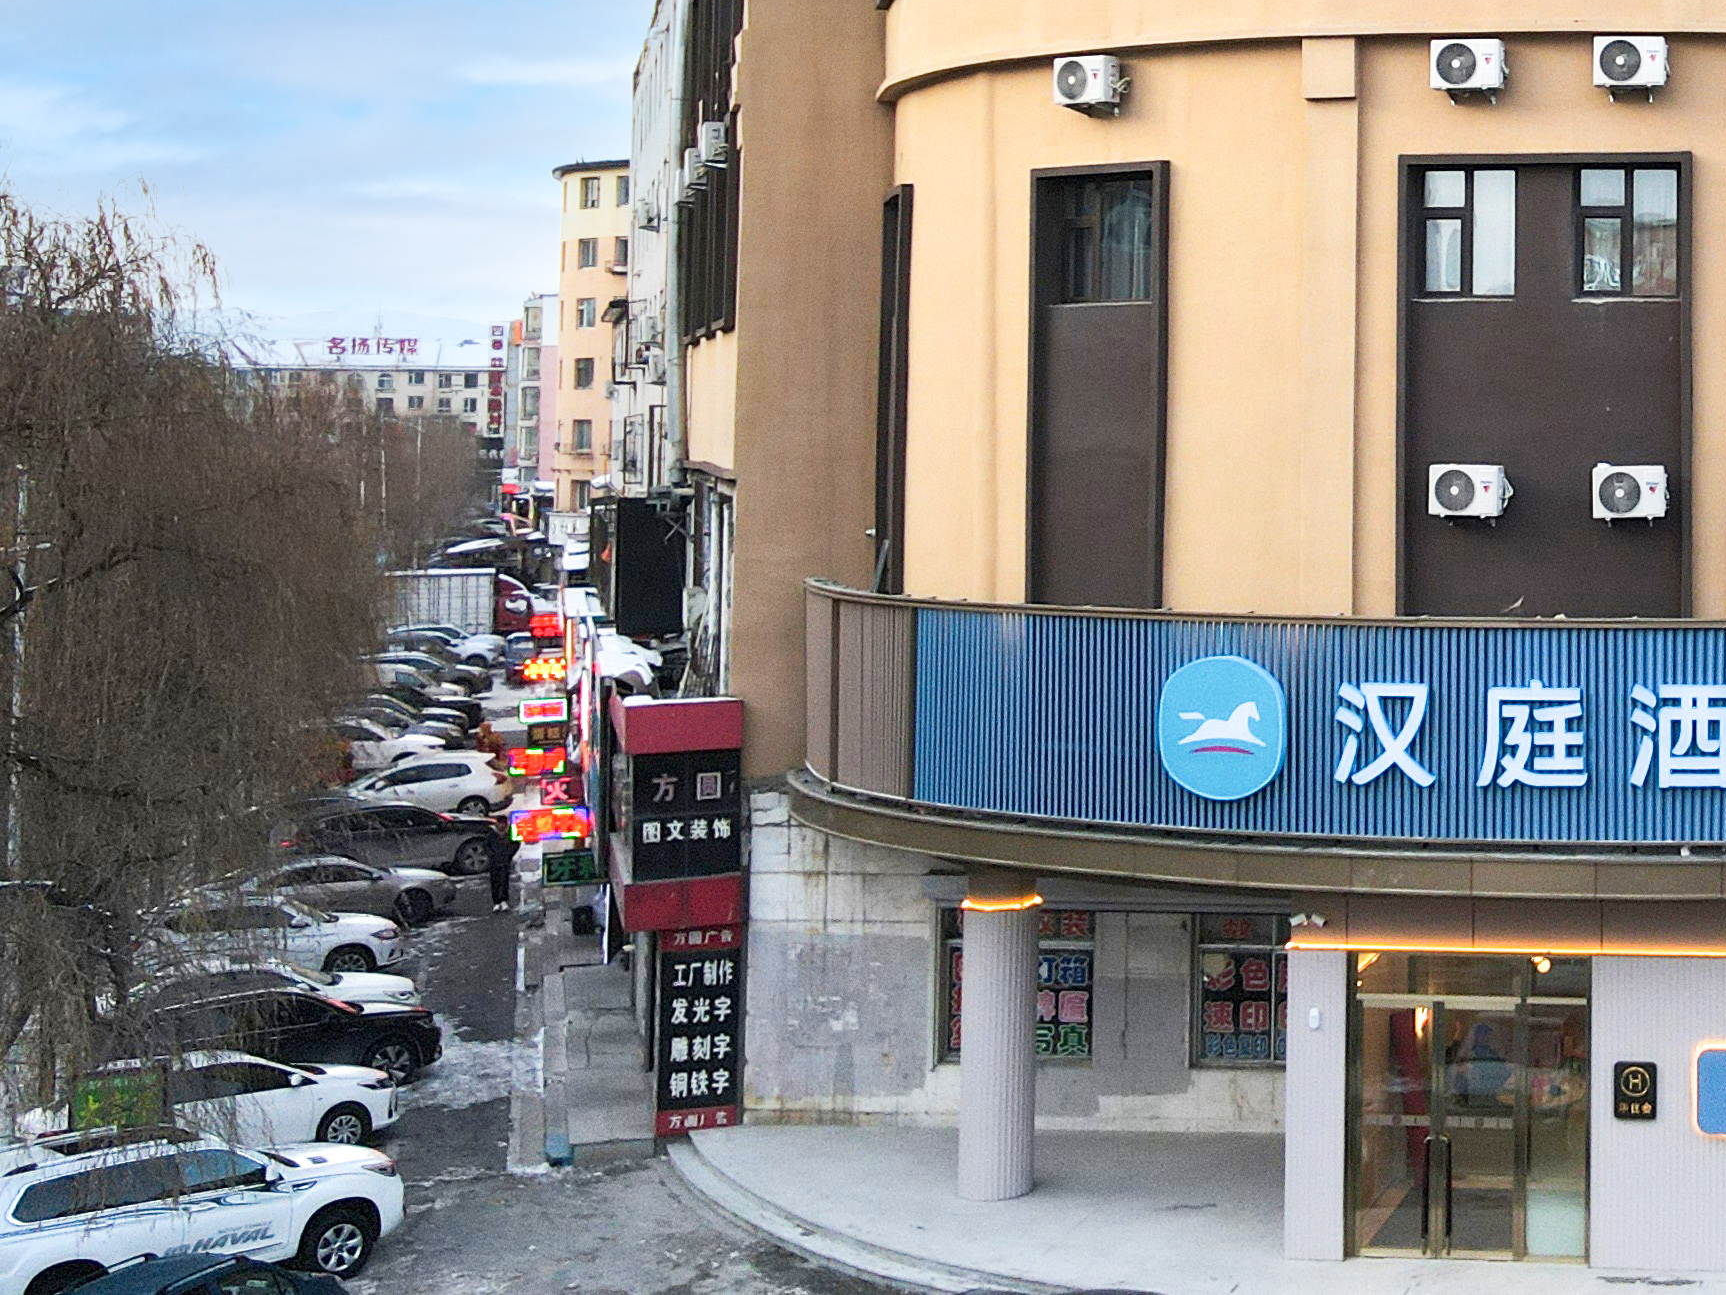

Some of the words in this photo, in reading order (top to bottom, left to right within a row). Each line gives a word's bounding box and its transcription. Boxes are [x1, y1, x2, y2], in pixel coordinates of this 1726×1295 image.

[642, 818, 732, 845] 图文装饰
[673, 929, 733, 946] 方圆广告
[673, 959, 734, 987] 工厂制作
[671, 996, 732, 1024] 发光字
[669, 1034, 732, 1063] 雕刻字
[191, 1226, 276, 1253] HAVAL
